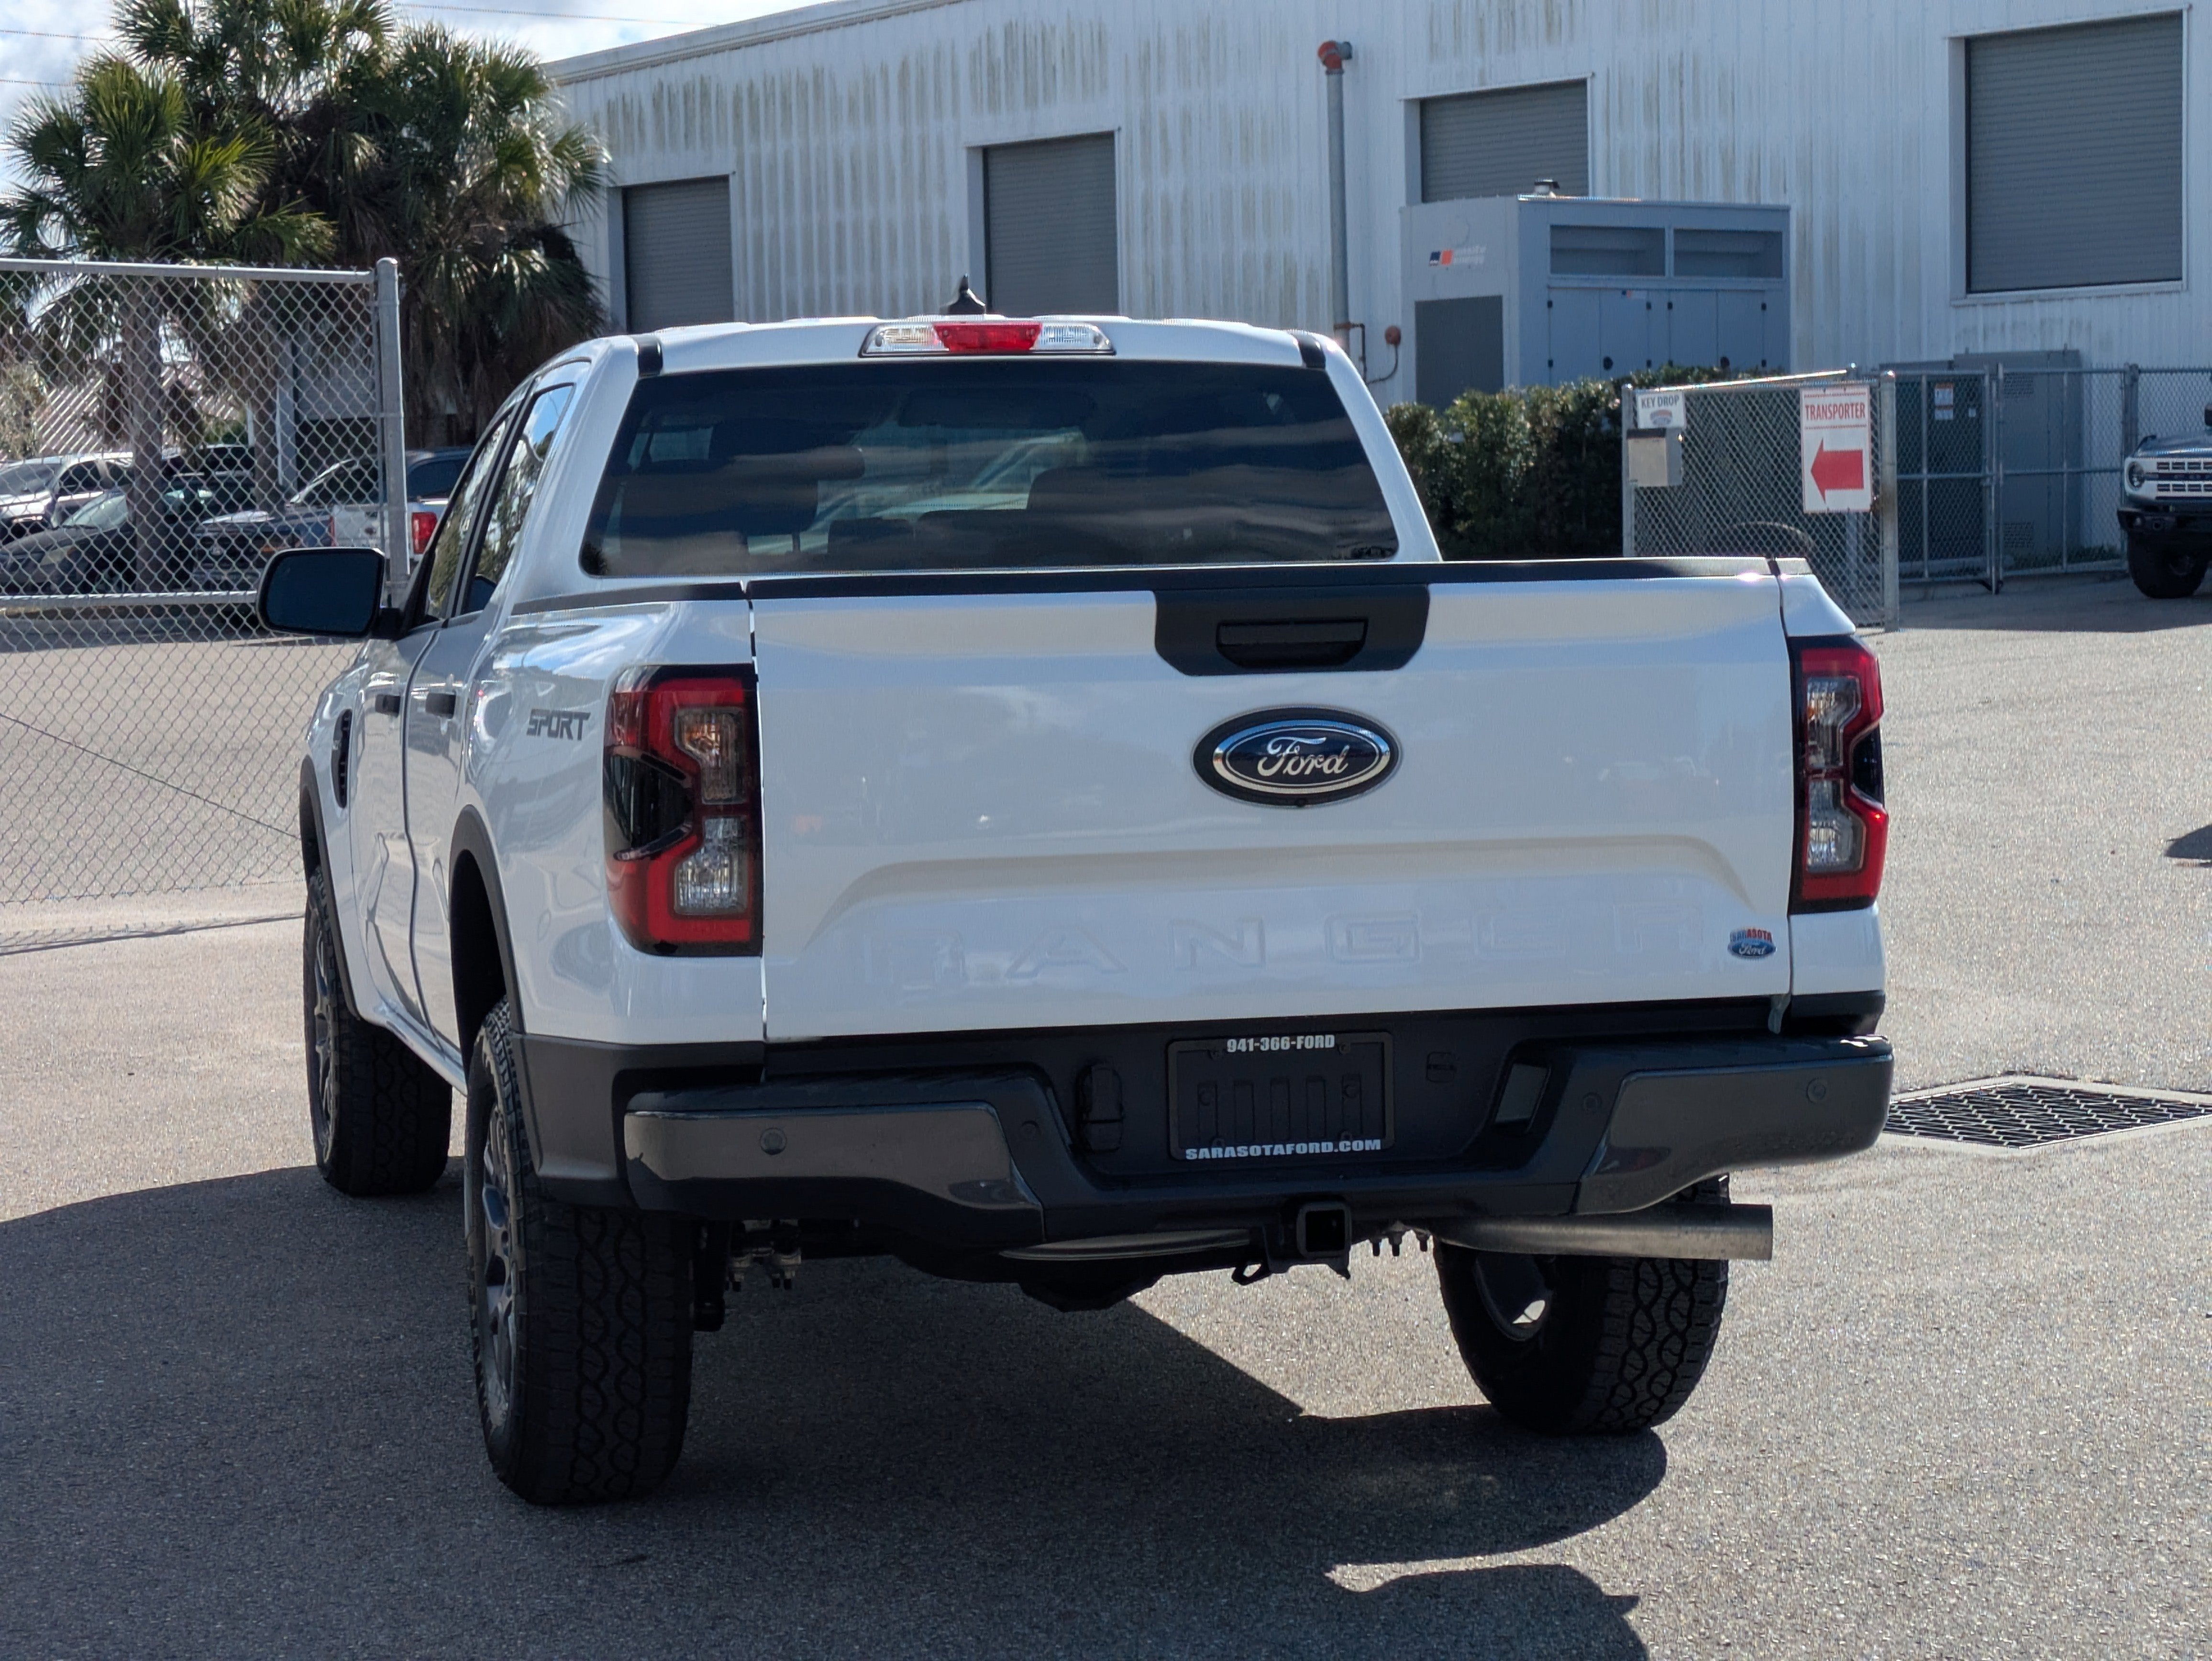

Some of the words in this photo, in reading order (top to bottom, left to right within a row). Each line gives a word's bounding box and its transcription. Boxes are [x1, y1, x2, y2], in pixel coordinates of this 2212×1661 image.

[1641, 397, 1655, 409] KEY
[1657, 394, 1680, 407] DROP
[1805, 402, 1865, 421] TRANSPORTER
[526, 709, 591, 741] SPORT
[1257, 736, 1350, 776] Ford
[1738, 944, 1768, 955] Ford
[1227, 1034, 1335, 1052] 941-366-FORD
[1185, 1139, 1381, 1160] SARASOTAFORD.COM
